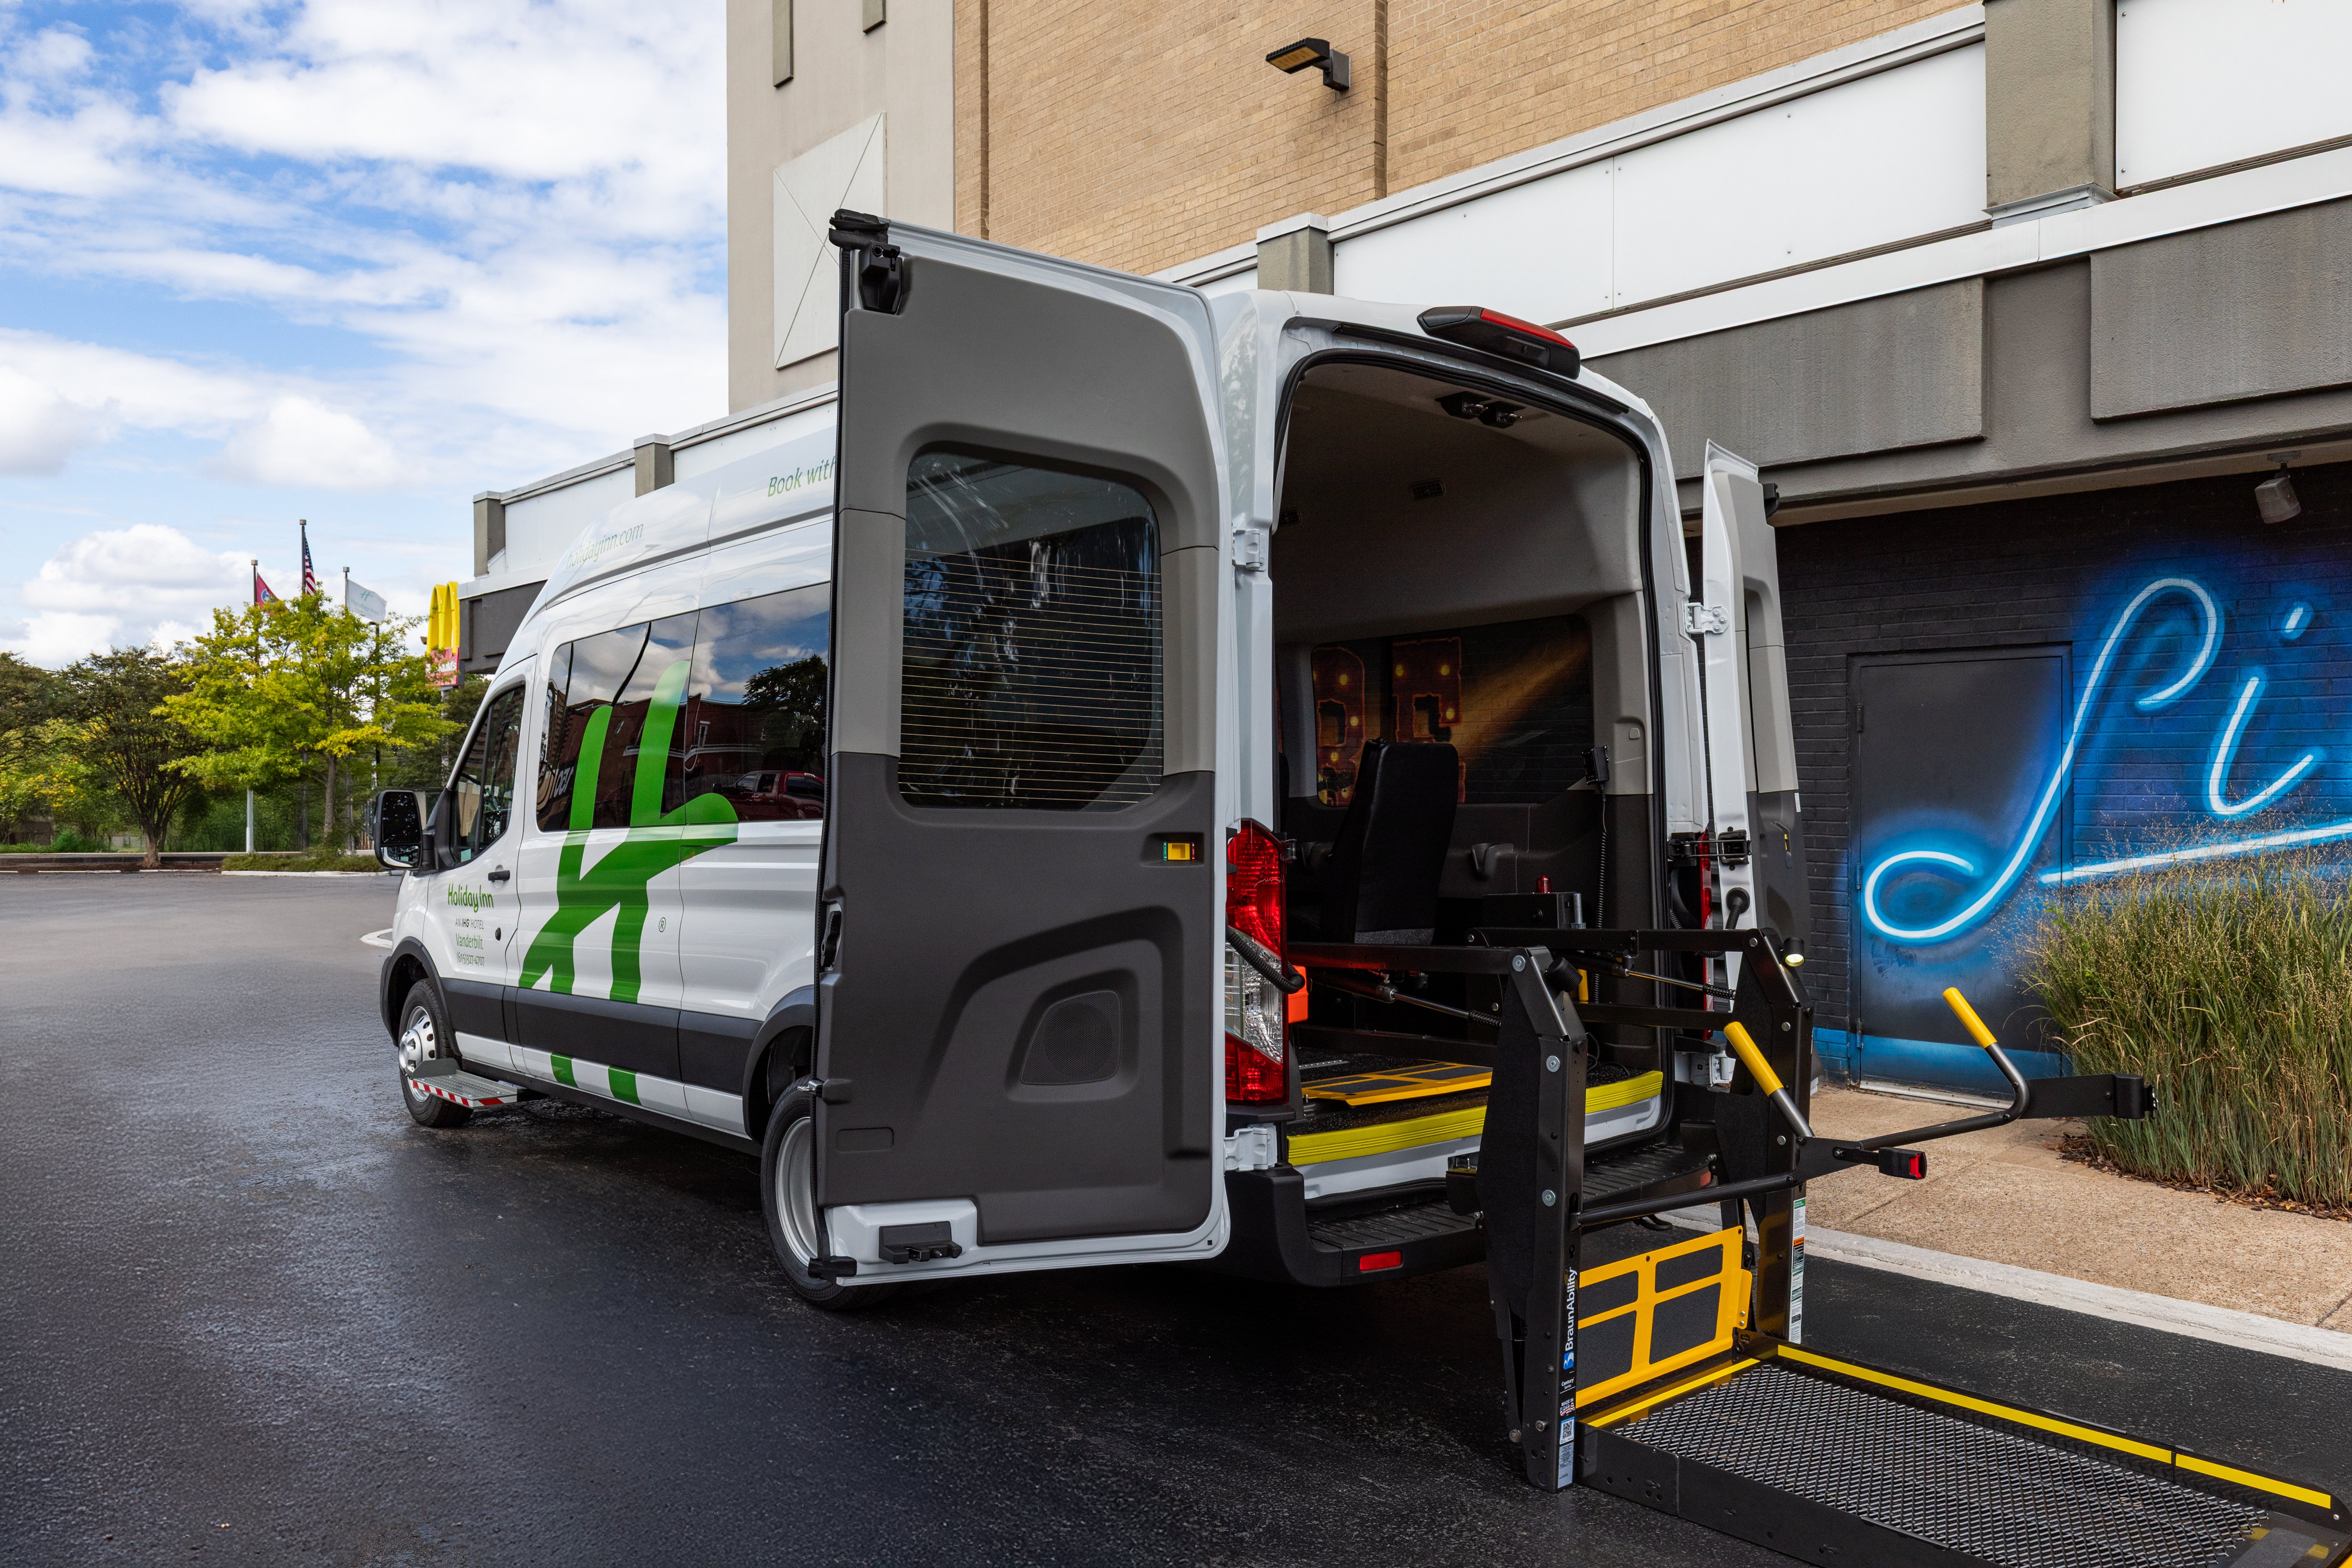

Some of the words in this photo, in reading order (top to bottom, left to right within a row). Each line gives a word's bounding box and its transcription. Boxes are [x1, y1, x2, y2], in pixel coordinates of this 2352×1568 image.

[768, 467, 803, 497] Book
[566, 523, 644, 570] holidayinn.com
[448, 883, 479, 913] Holiday
[479, 884, 494, 908] Inn
[455, 918, 461, 927] AN
[470, 920, 484, 929] HOTEL
[456, 933, 483, 949] Vanderbilt
[457, 951, 485, 967] (615)327-4707
[1565, 1268, 1577, 1351] BraunAbility
[1561, 1378, 1574, 1386] Century
[1560, 1402, 1575, 1417] USA
